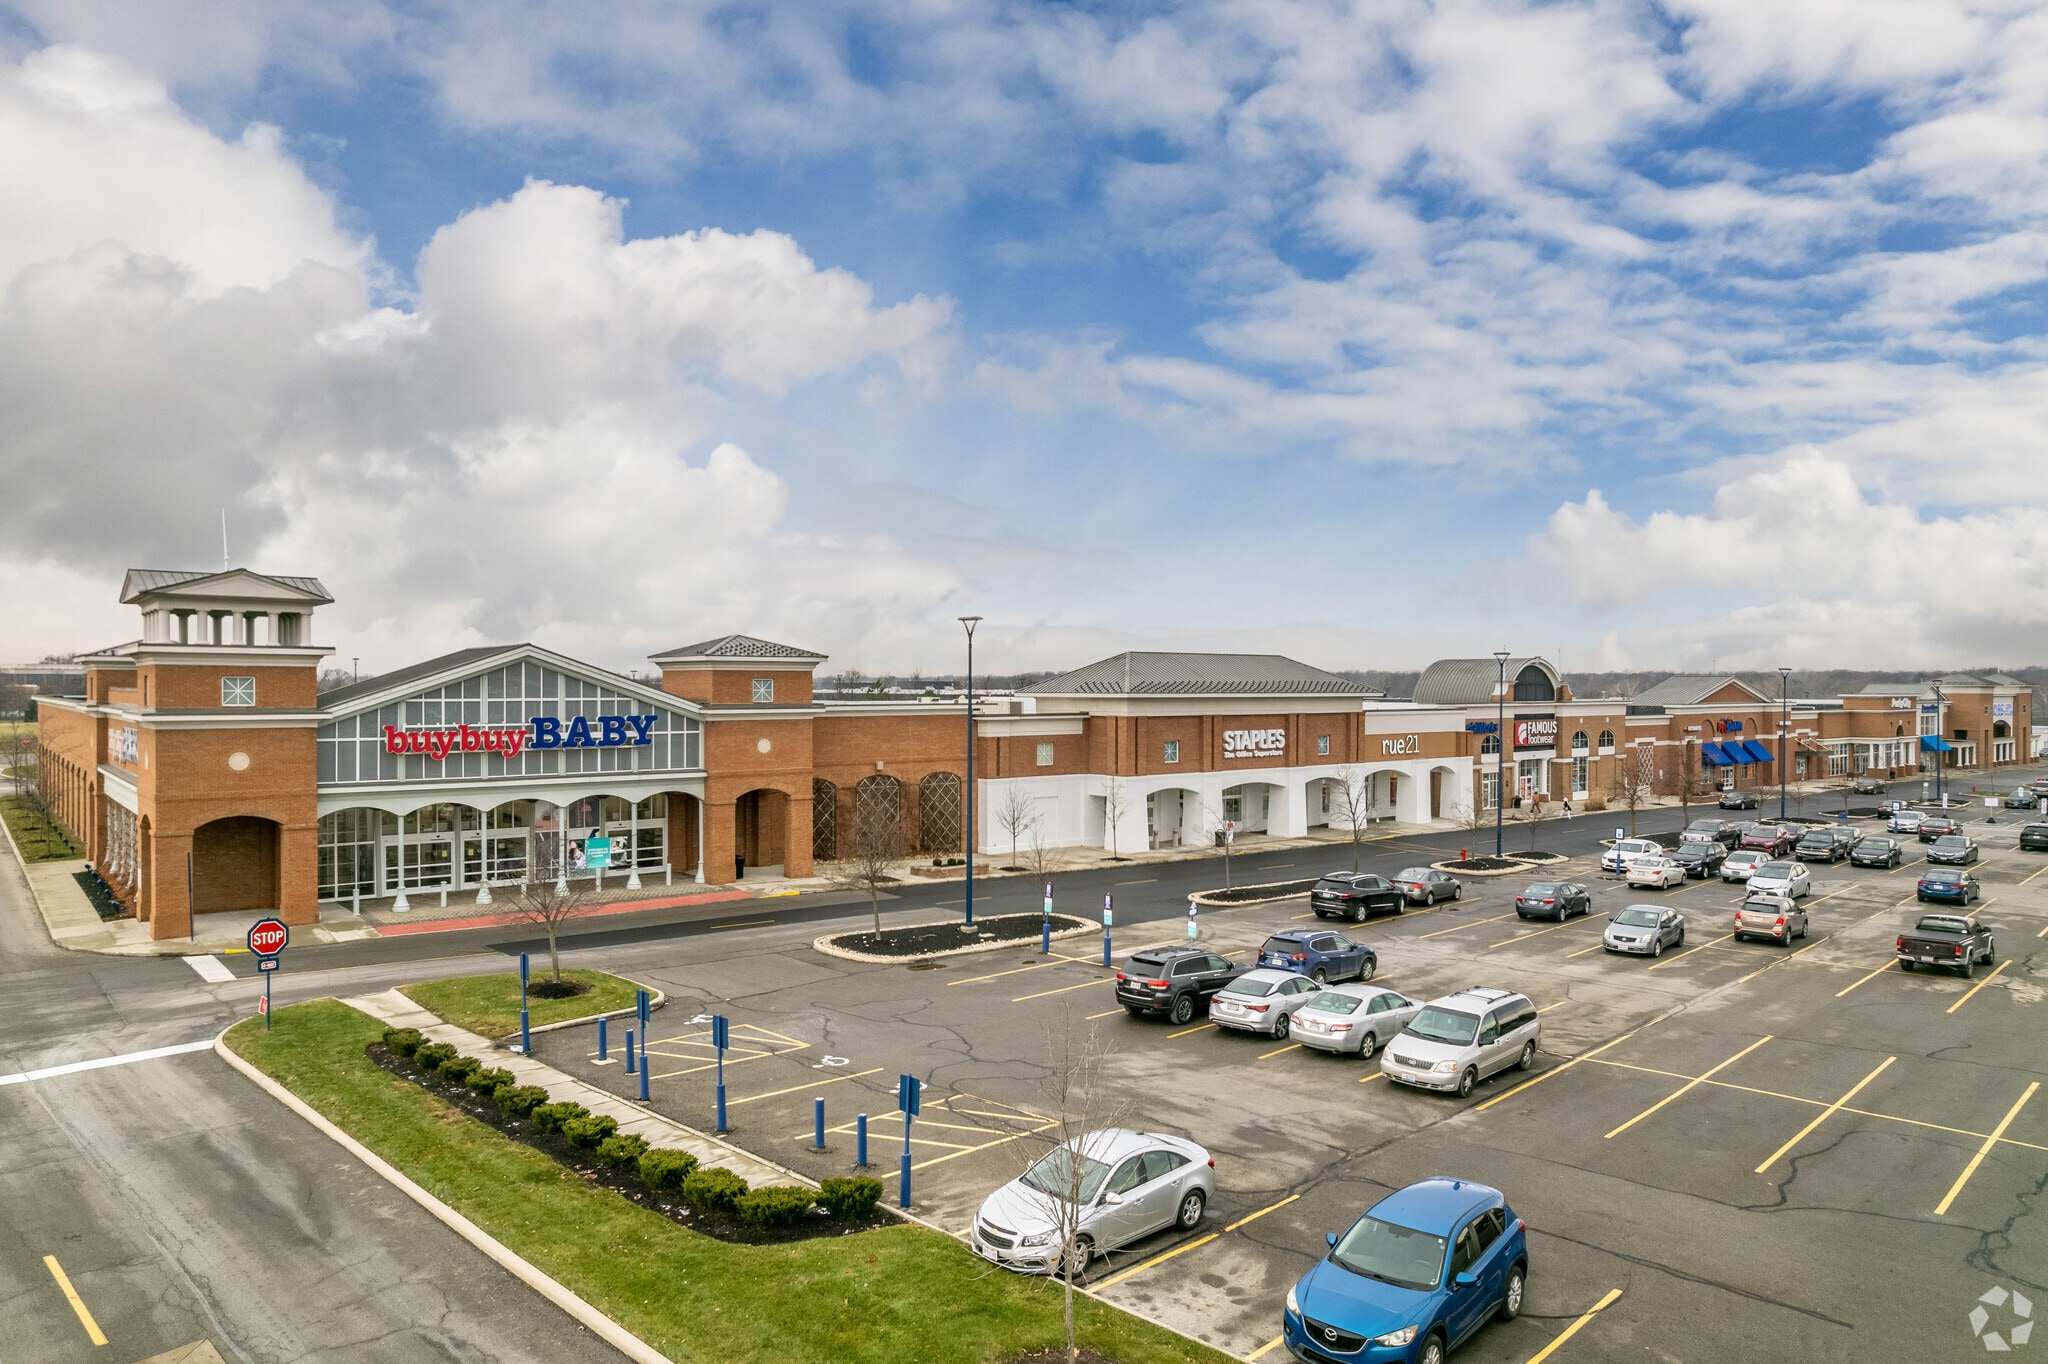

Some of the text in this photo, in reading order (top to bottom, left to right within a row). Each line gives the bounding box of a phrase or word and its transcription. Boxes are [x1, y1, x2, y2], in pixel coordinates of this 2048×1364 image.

[1527, 721, 1558, 734] FAMOUS
[1223, 728, 1286, 751] STAPLES
[1382, 735, 1420, 755] rue21
[253, 930, 284, 946] STOP
